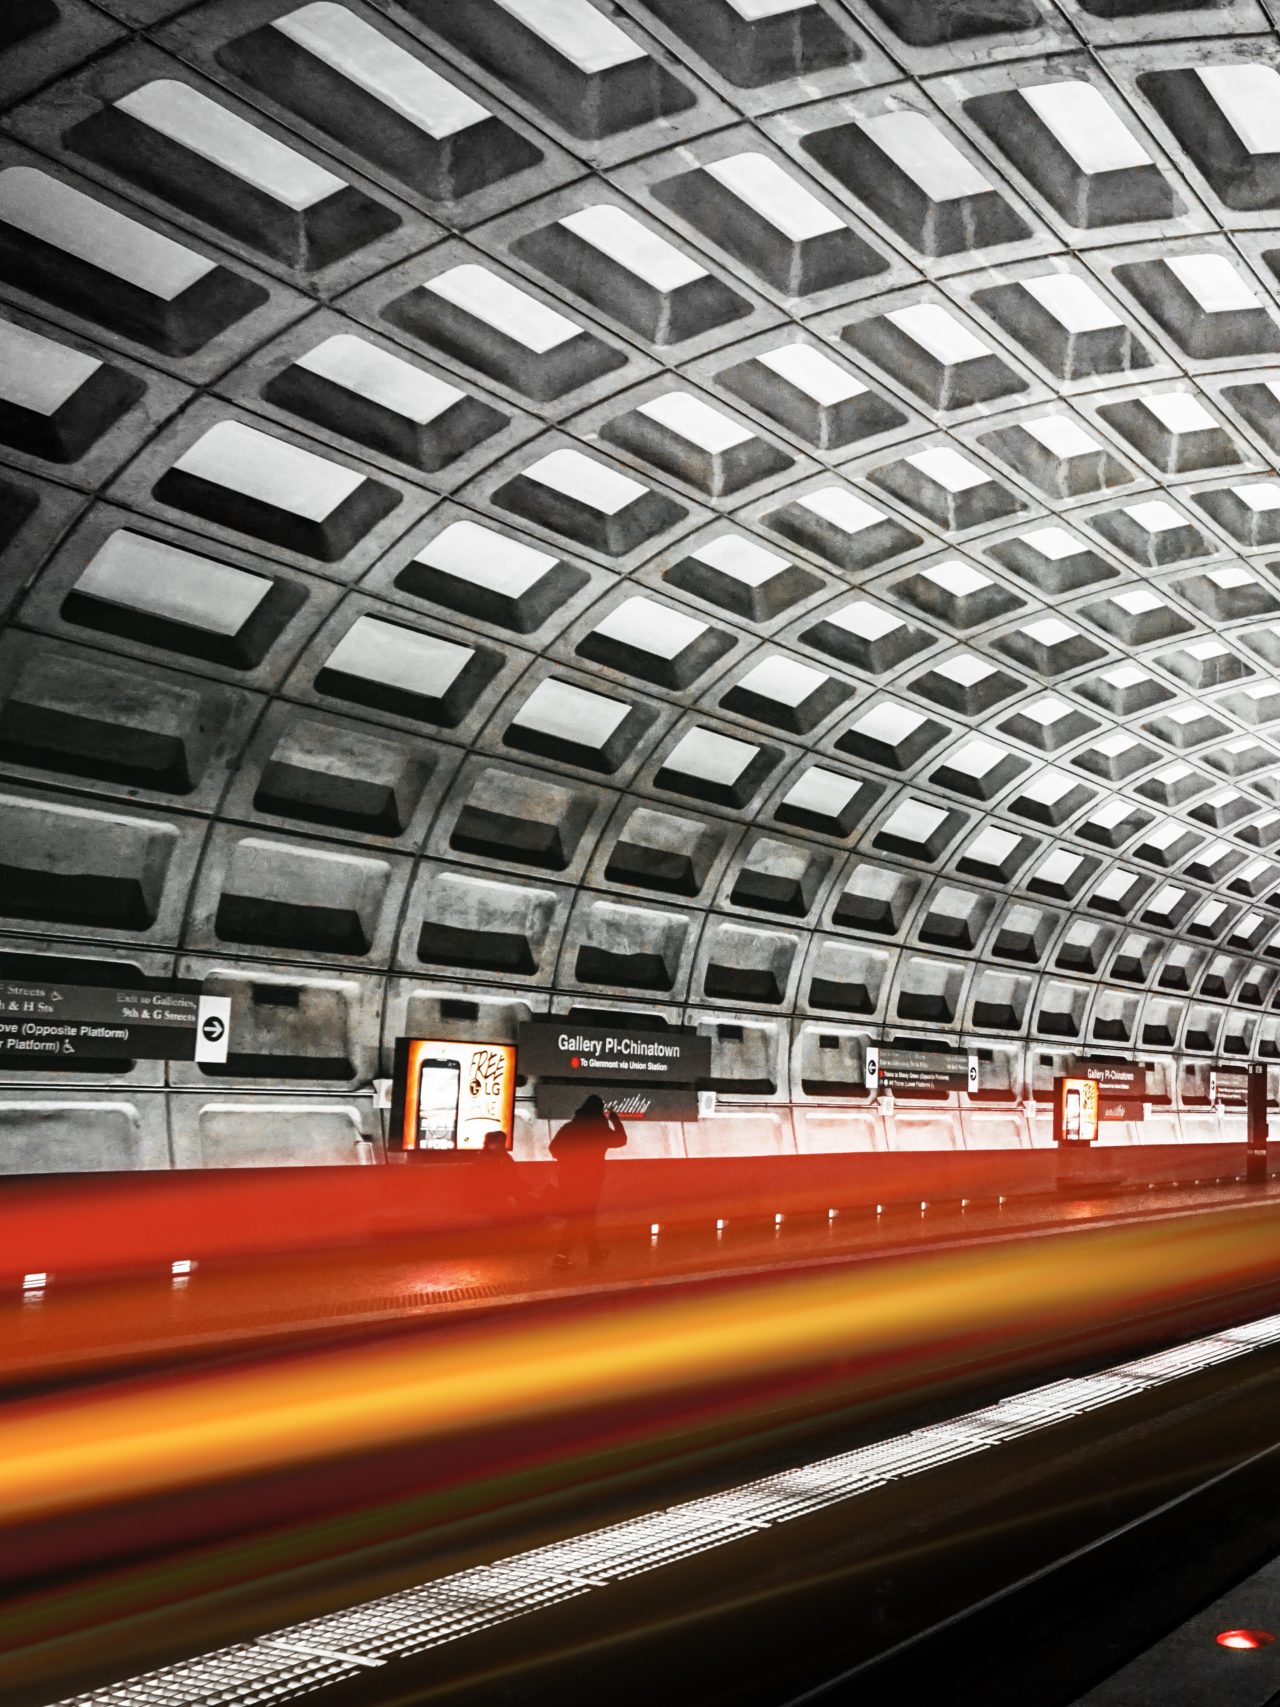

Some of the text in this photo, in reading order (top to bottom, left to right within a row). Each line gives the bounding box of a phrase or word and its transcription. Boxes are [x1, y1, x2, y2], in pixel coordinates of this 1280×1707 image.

[8, 1000, 20, 1011] &
[23, 1001, 35, 1012] H
[152, 1009, 163, 1020] G
[22, 1022, 78, 1037] (Opposite
[80, 1025, 129, 1041] Platform)
[7, 1038, 60, 1054] Platform)
[558, 1033, 681, 1058] Gallery Pl-Chinatown
[469, 1049, 506, 1082] FREE
[1087, 1068, 1105, 1081] Gallery
[484, 1082, 501, 1096] LG
